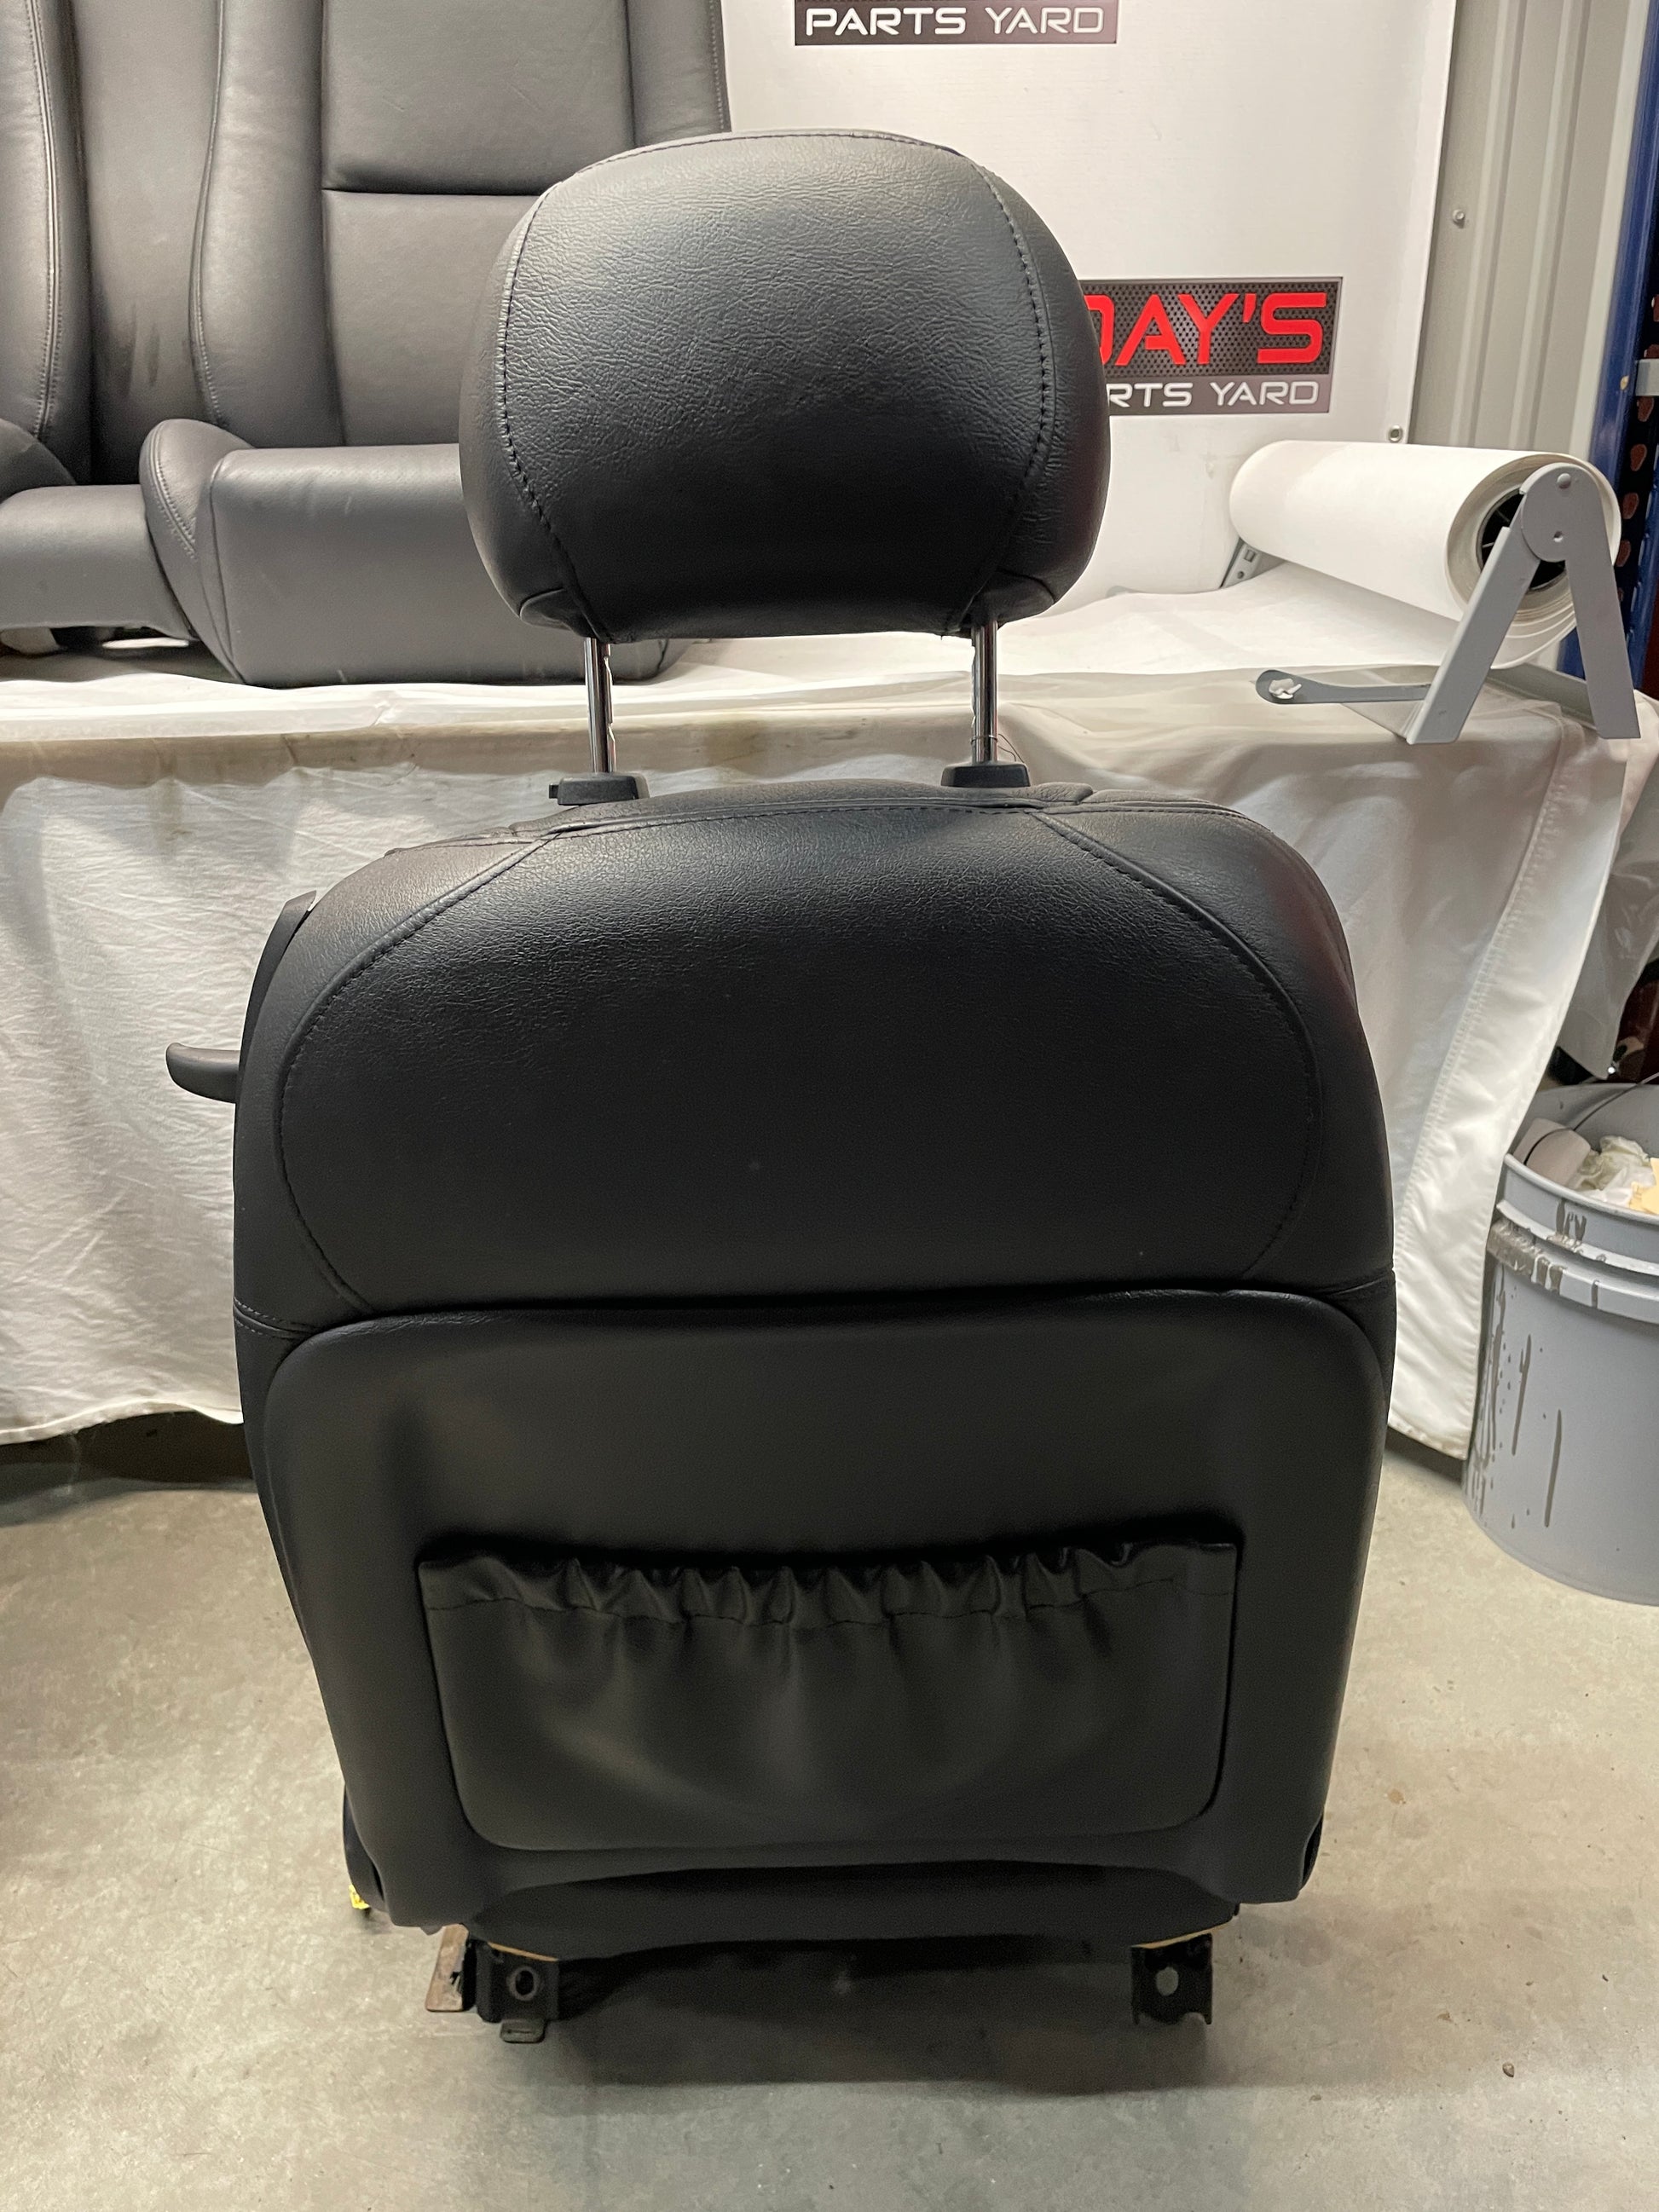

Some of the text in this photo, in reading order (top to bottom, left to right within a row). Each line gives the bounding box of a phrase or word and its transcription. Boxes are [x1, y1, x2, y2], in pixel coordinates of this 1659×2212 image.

[805, 7, 1104, 36] PARTS YARD
[1106, 381, 1319, 407] RTS YARD
